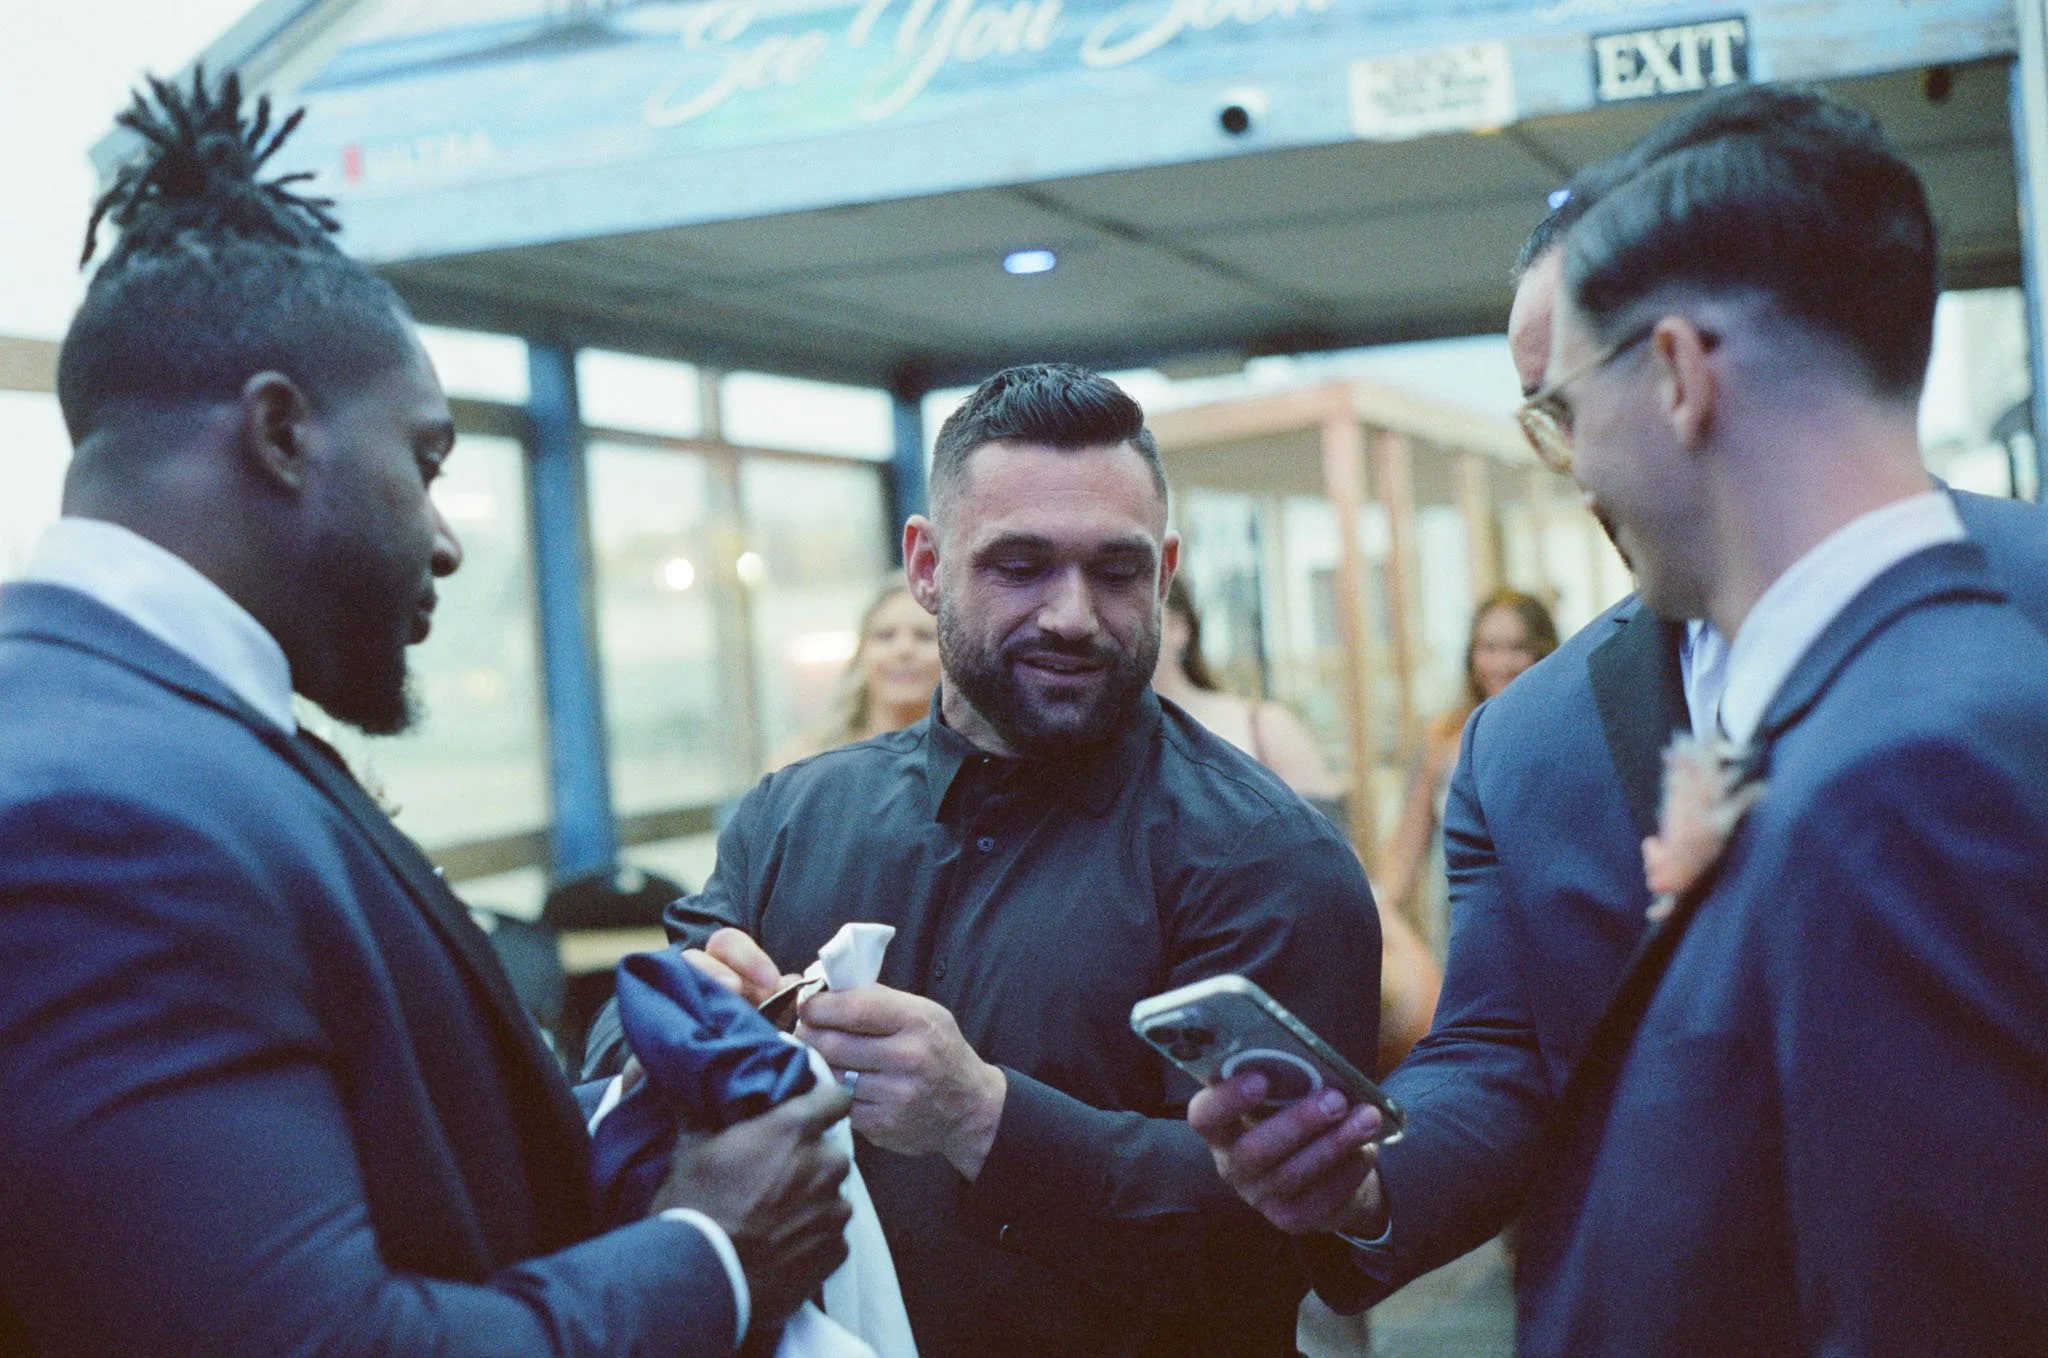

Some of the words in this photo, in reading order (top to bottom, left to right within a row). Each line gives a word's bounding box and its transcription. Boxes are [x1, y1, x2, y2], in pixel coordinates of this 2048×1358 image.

[642, 0, 829, 127] See
[848, 0, 1061, 120] You
[1597, 20, 1746, 100] EXIT
